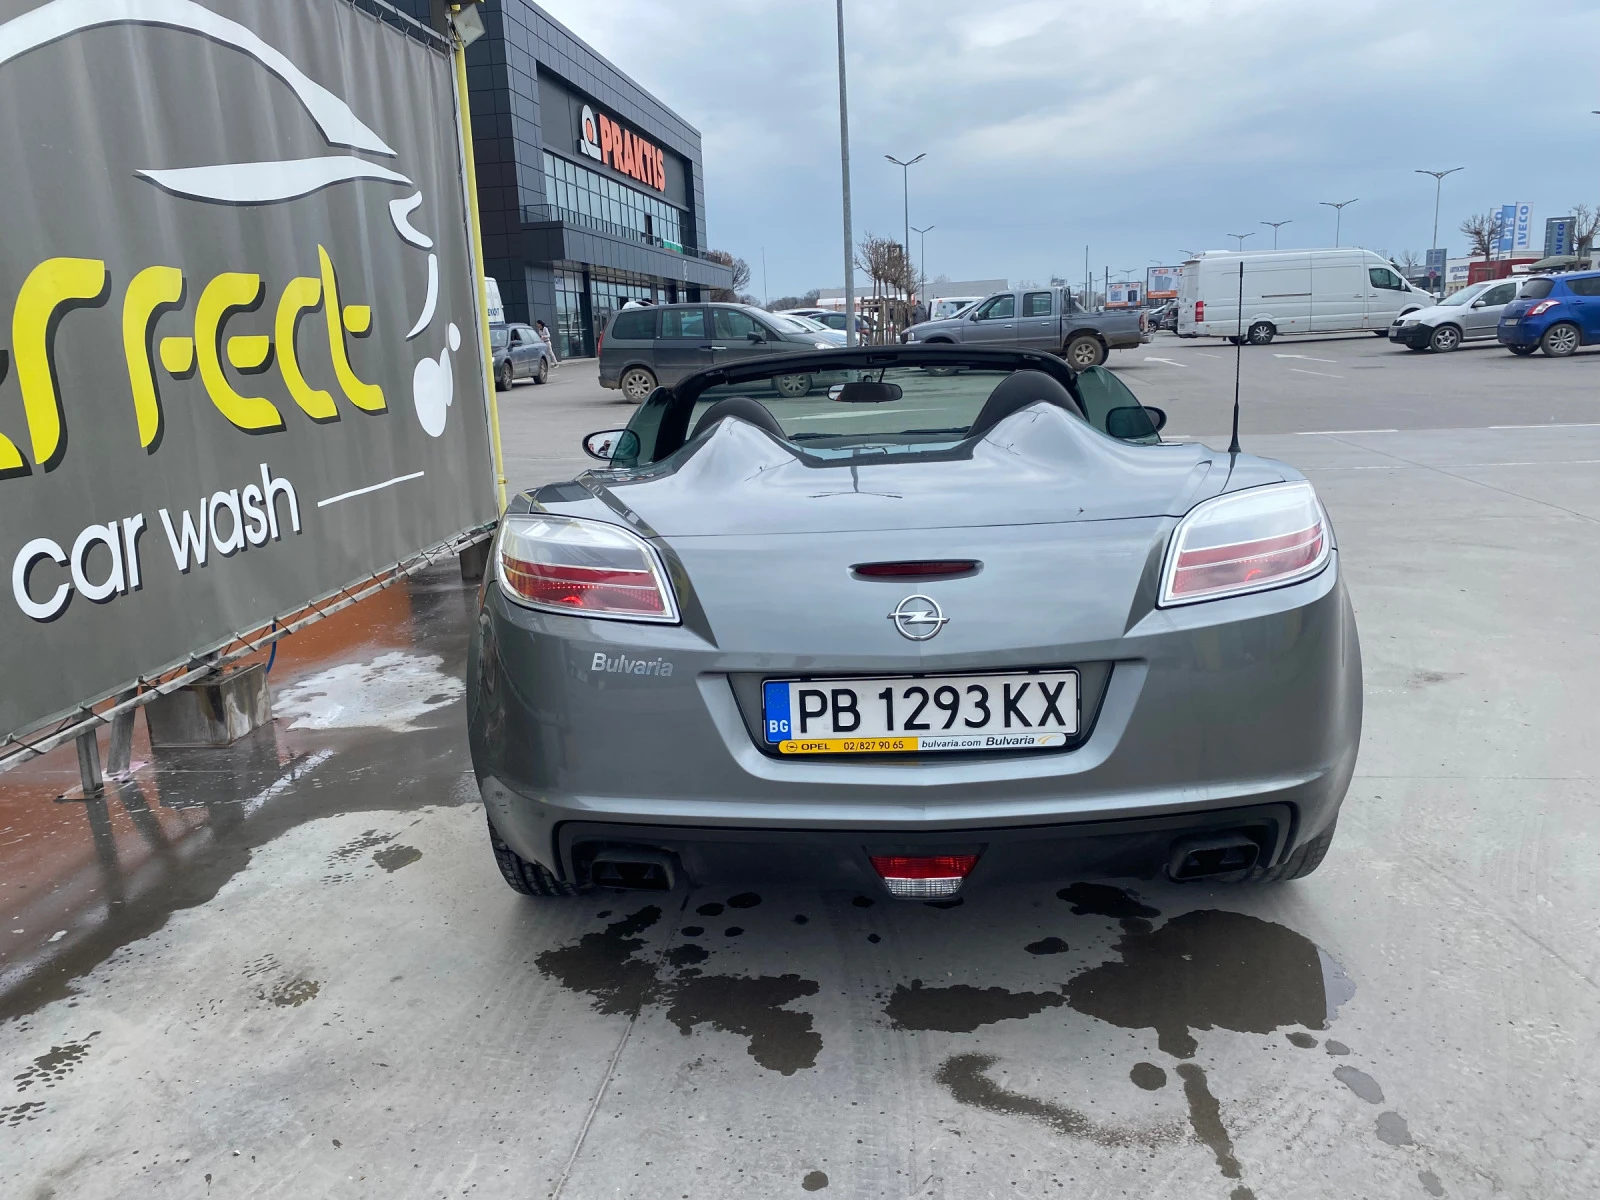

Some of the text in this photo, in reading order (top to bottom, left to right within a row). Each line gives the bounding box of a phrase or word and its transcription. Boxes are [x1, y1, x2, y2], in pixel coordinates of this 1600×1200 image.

[599, 113, 665, 192] PRAKTIS
[1517, 205, 1529, 246] IVECO
[1555, 223, 1565, 255] IVECO
[11, 462, 301, 619] car wash
[591, 652, 674, 677] Bulvaria
[798, 681, 1067, 733] PB 1293 KX
[769, 719, 789, 733] BG
[921, 736, 1035, 748] bulvaria.com Bulvaria
[801, 740, 904, 751] OPEL 02/827 90 65
